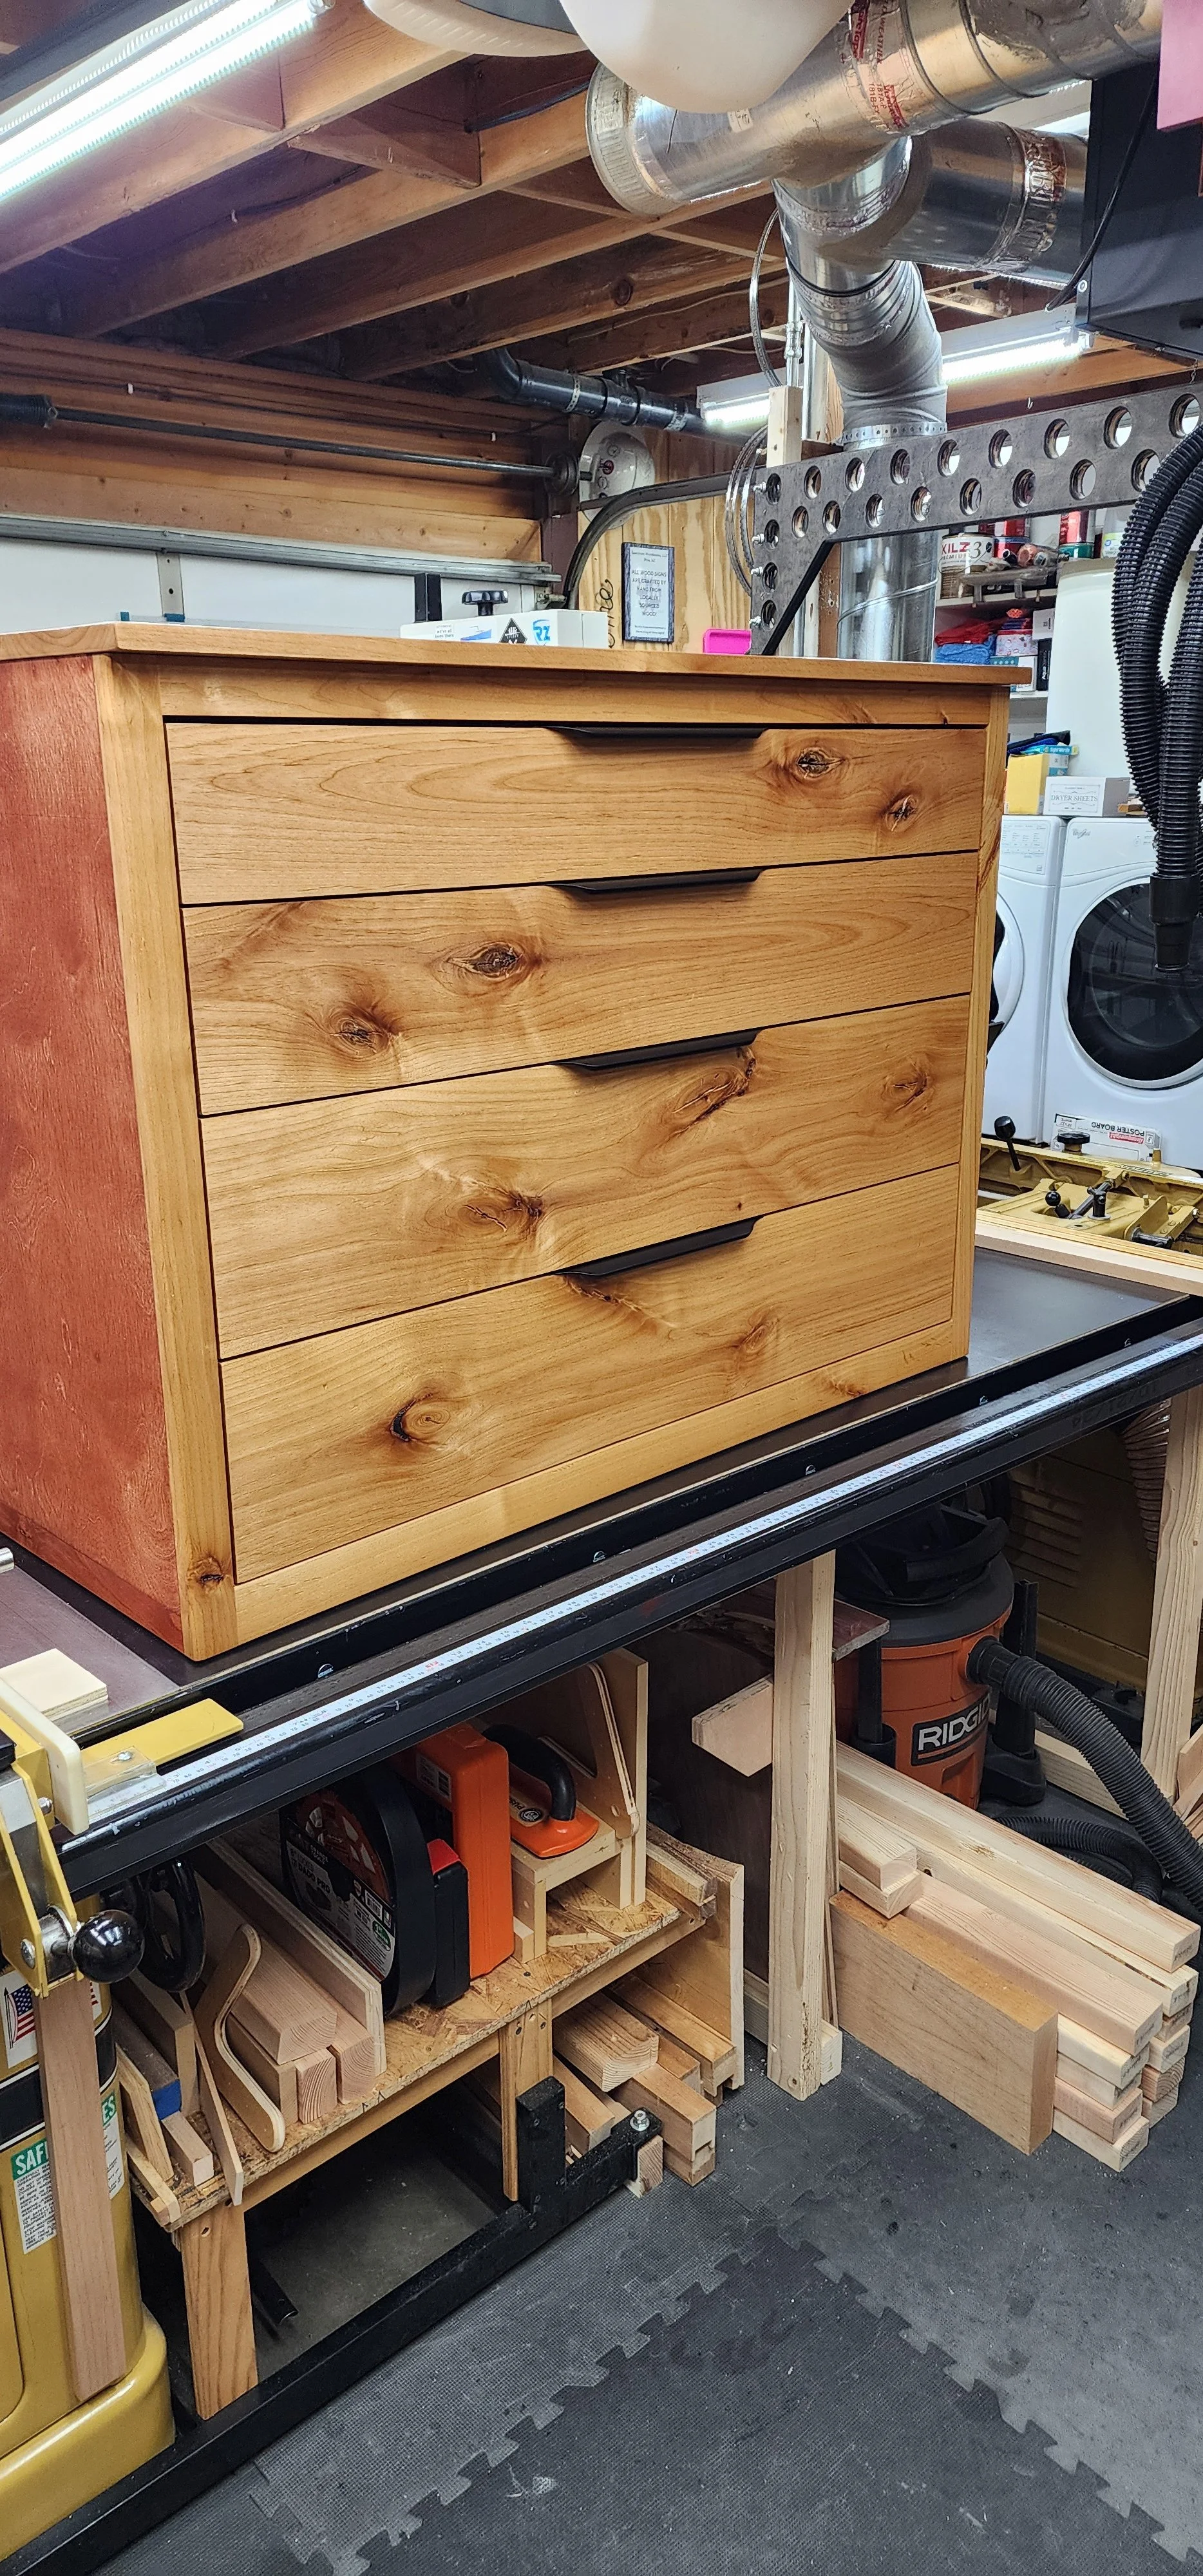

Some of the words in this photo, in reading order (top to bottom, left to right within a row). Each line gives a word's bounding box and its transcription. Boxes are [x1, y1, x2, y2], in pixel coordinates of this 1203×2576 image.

[942, 542, 970, 554] KILZ
[969, 542, 981, 559] 3
[1091, 1121, 1115, 1130] BOARD
[1117, 1126, 1145, 1136] POSTER
[918, 1693, 990, 1751] RIDGID
[317, 1875, 331, 1894] PRO
[15, 2141, 49, 2175] SAF
